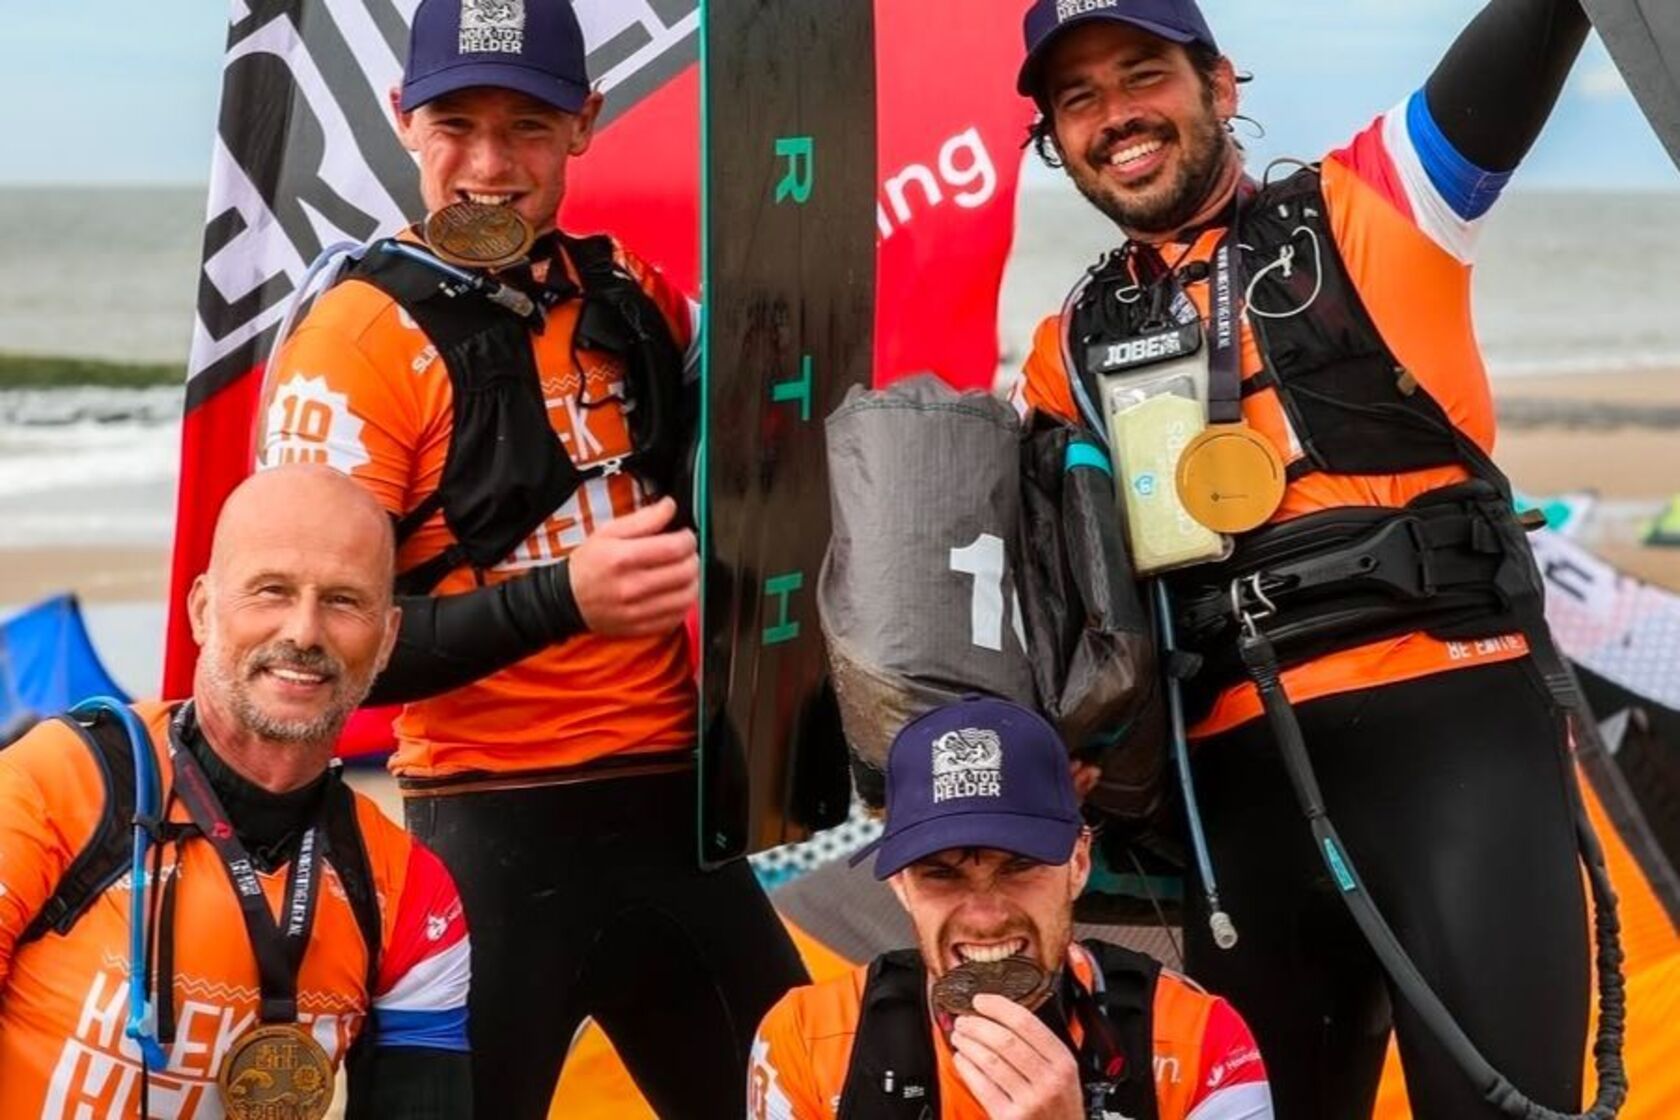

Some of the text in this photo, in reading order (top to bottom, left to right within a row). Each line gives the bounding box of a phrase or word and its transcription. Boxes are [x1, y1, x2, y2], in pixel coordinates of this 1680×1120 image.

[459, 38, 522, 55] HELDER
[1103, 334, 1165, 367] JOBE
[282, 395, 332, 443] 10
[950, 532, 1029, 655] 1
[933, 781, 1001, 804] HELDER
[75, 970, 258, 1078] HEK
